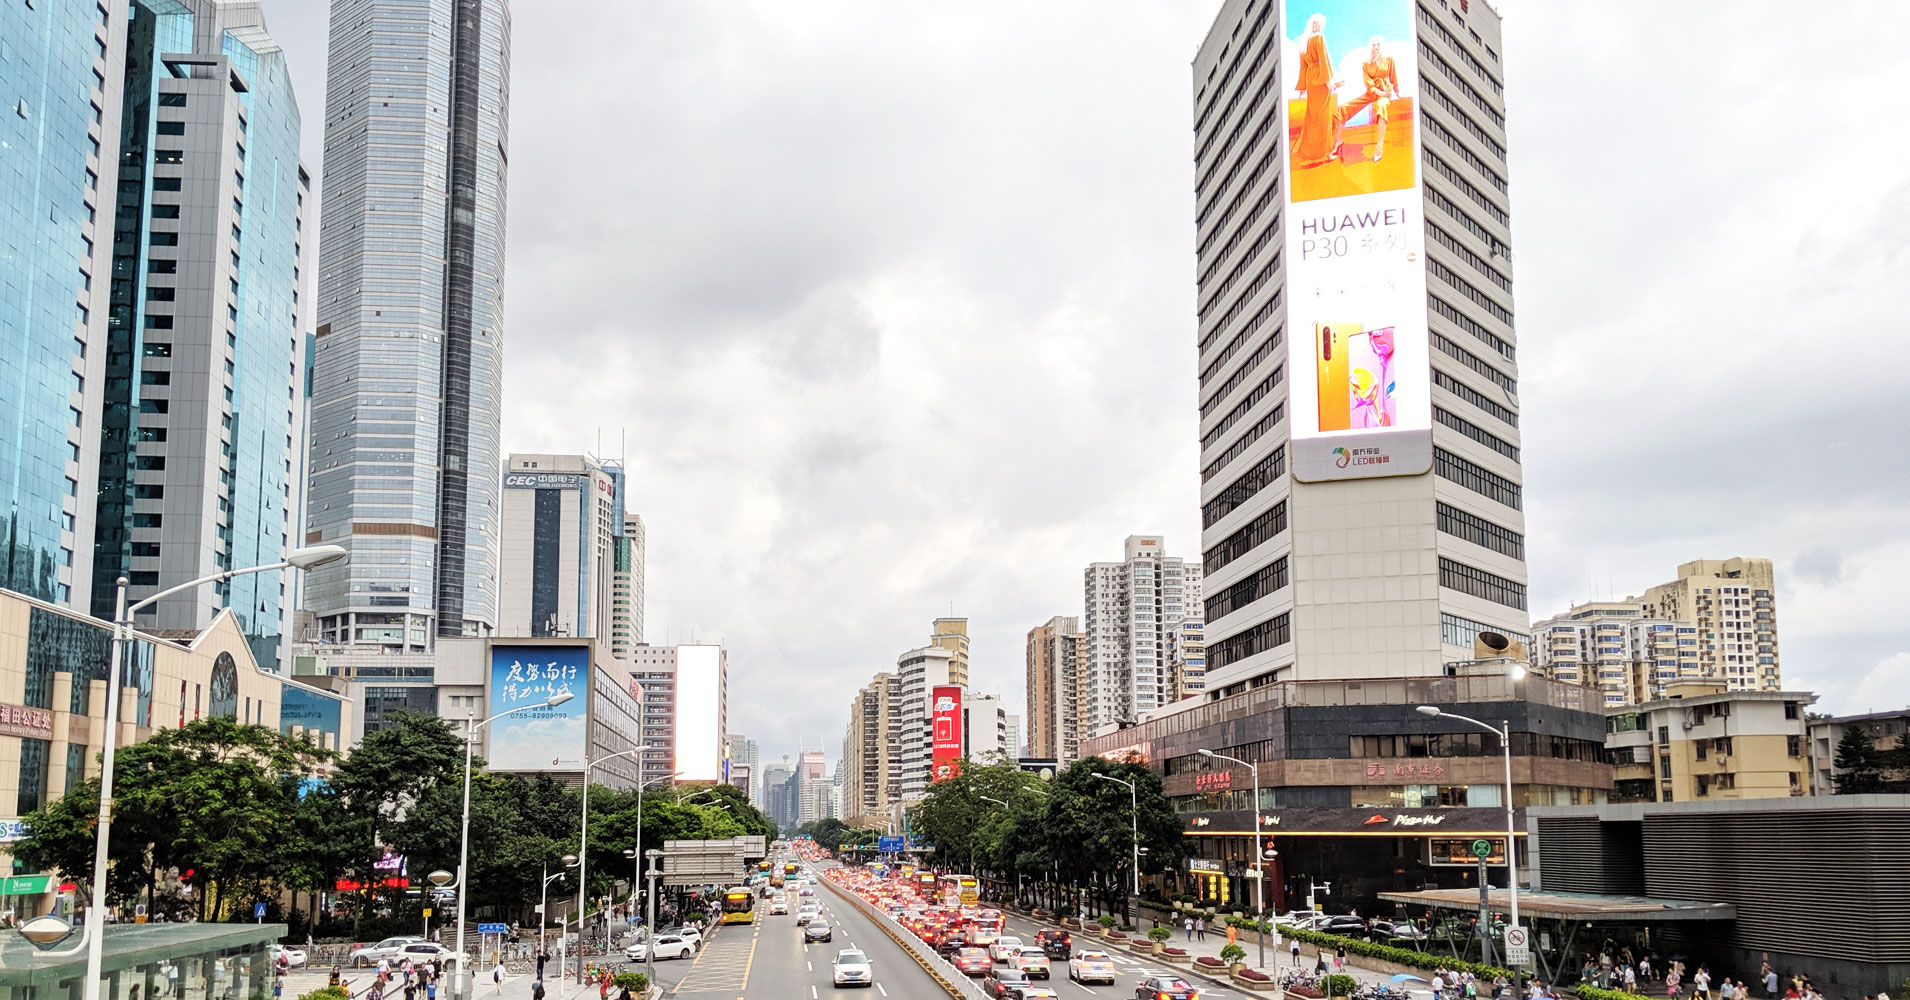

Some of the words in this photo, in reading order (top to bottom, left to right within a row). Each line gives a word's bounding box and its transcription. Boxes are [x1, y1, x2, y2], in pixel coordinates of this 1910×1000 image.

[1302, 208, 1405, 235] HUAWEI
[1302, 235, 1348, 261] P30
[1361, 229, 1407, 254] 系列
[506, 475, 537, 486] CEC
[537, 474, 577, 484] 中国电子
[1393, 814, 1423, 826] Pizza
[1422, 814, 1445, 825] Hut
